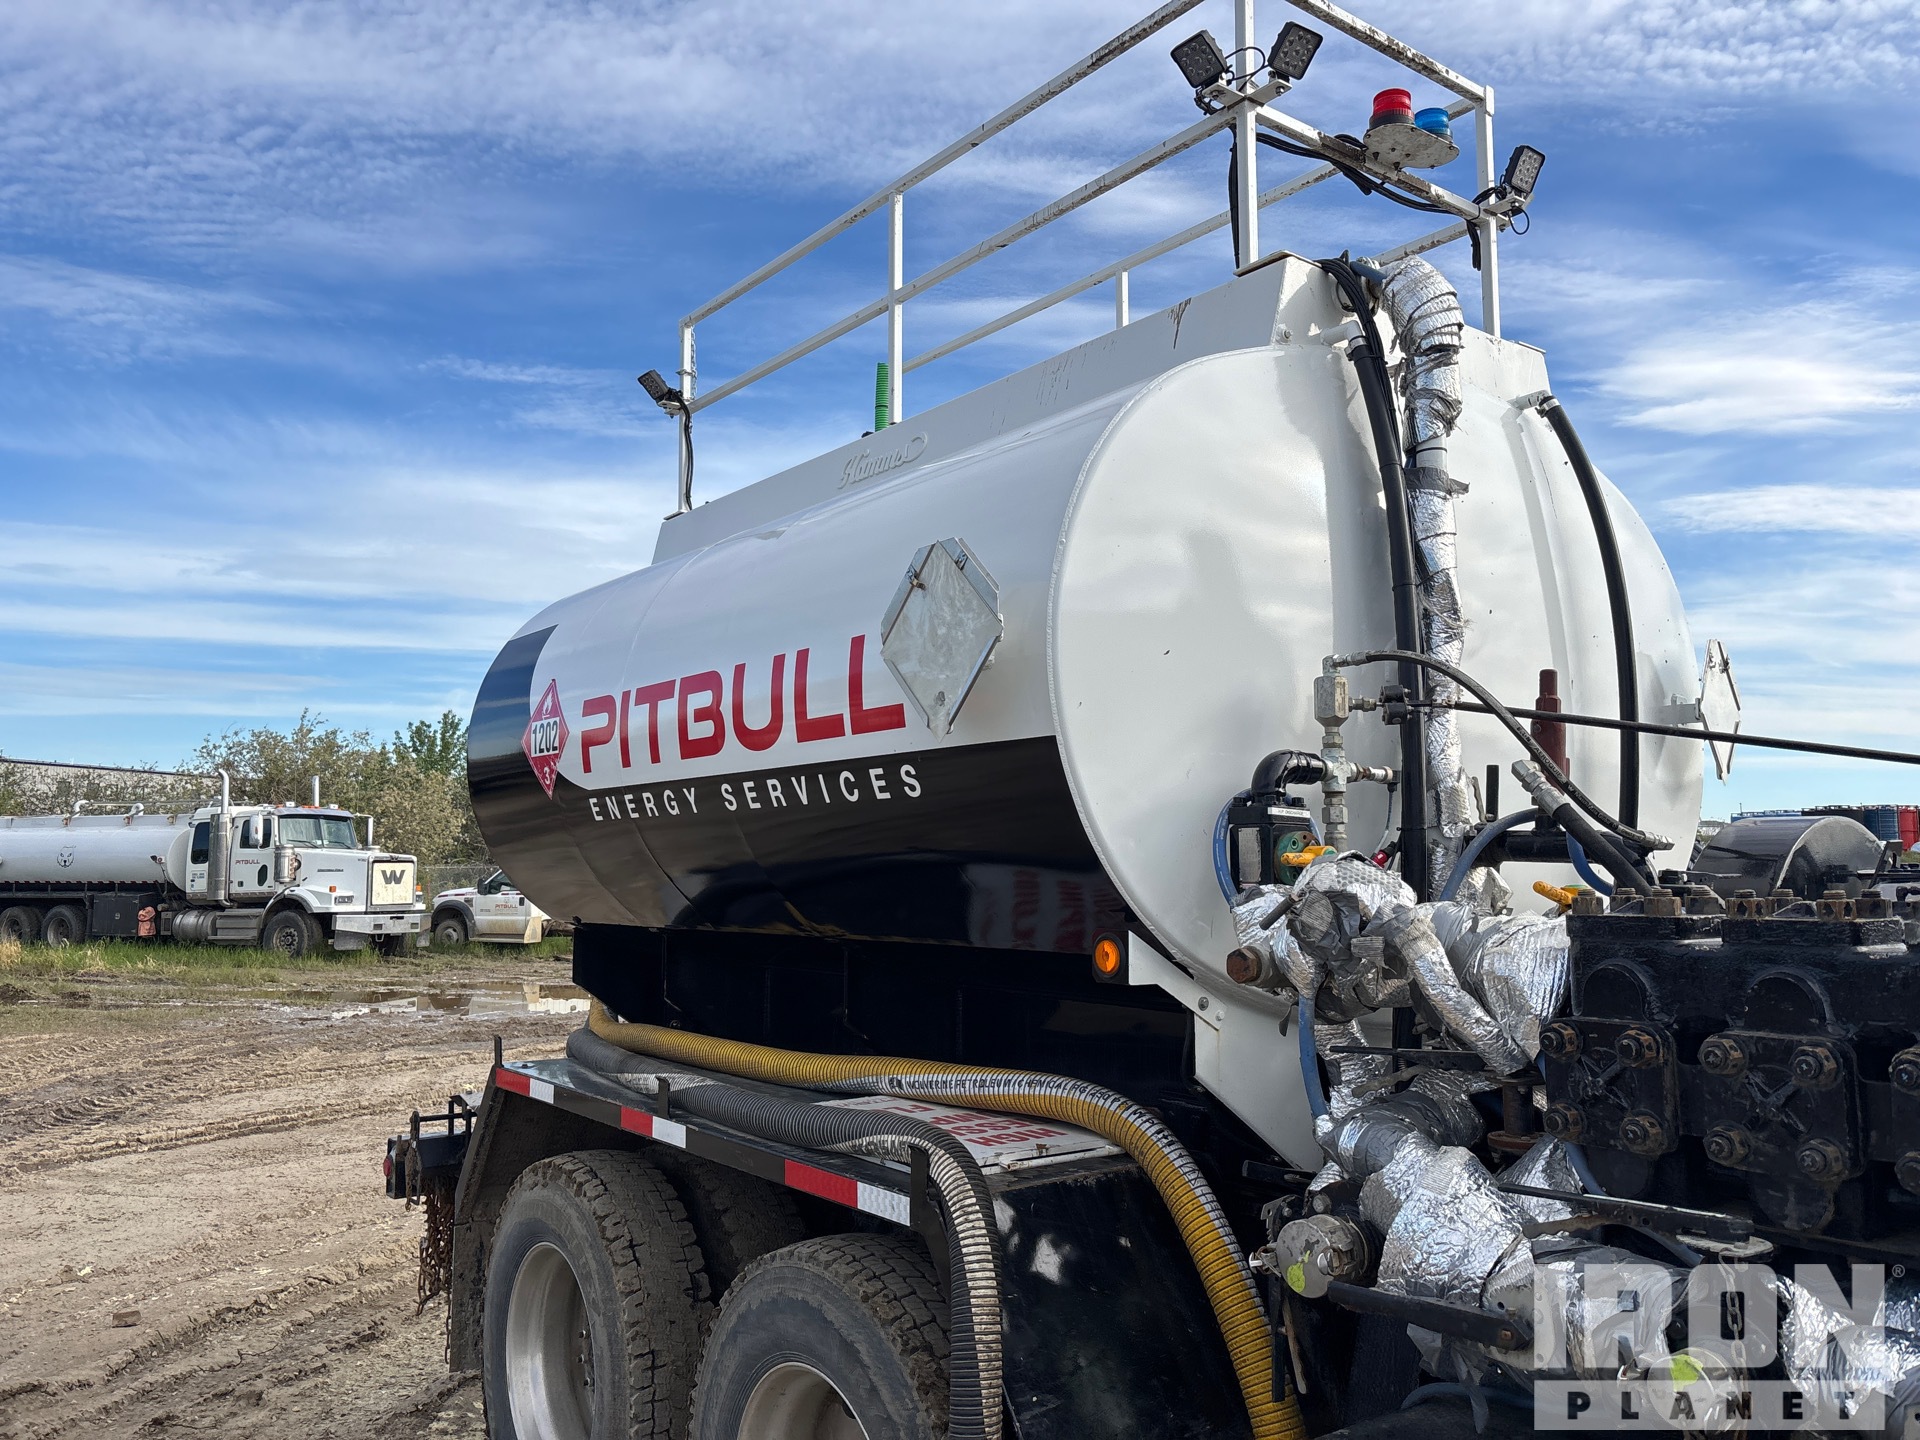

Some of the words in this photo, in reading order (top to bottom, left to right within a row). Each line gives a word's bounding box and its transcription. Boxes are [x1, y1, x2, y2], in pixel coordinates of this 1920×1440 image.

[580, 634, 906, 774] PITBULL
[532, 720, 558, 755] 1202
[543, 766, 551, 785] 3
[588, 787, 698, 821] ENERGY
[720, 764, 922, 812] SERVICES
[381, 869, 406, 885] W
[963, 1127, 1069, 1147] HIGH
